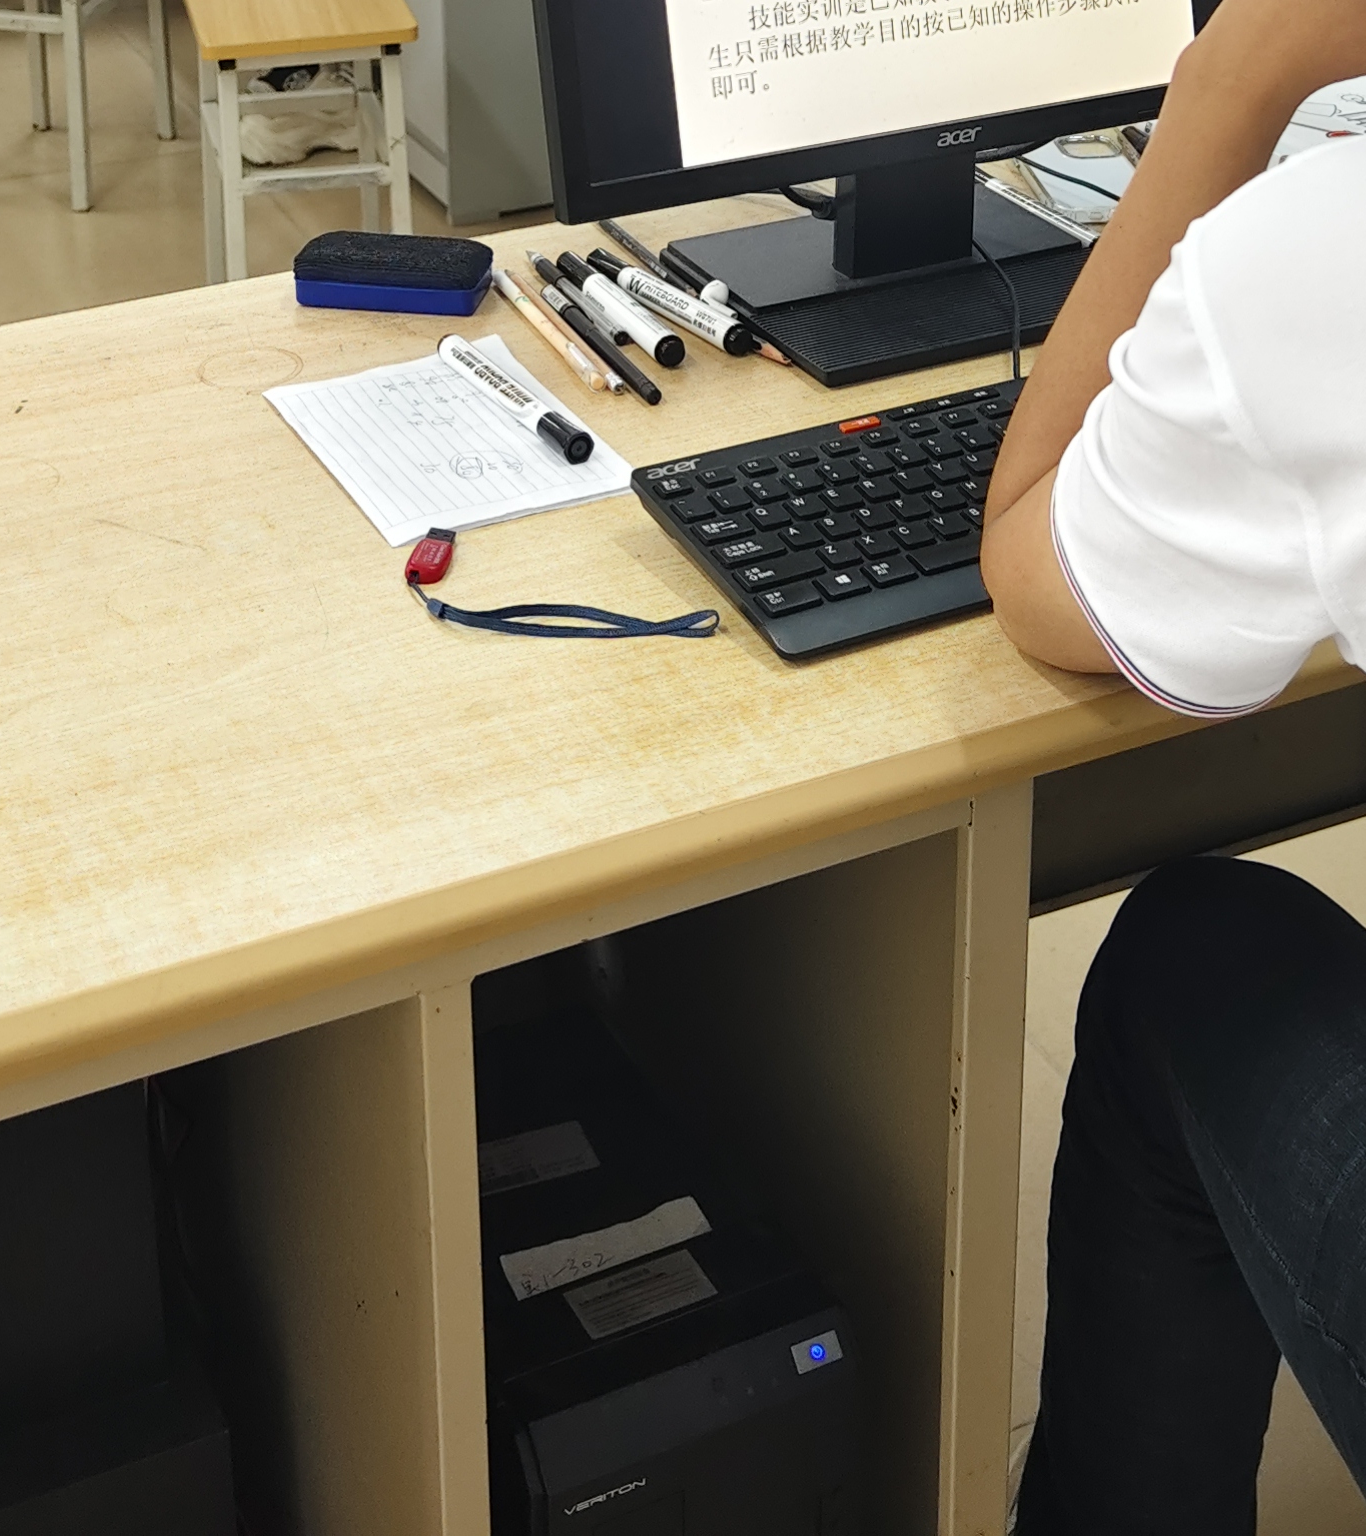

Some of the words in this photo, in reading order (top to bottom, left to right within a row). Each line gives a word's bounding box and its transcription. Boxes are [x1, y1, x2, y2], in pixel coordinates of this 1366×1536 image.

[711, 70, 770, 100] 即可。
[937, 125, 983, 147] acer
[646, 458, 701, 480] acer
[564, 1477, 647, 1515] VERITON
